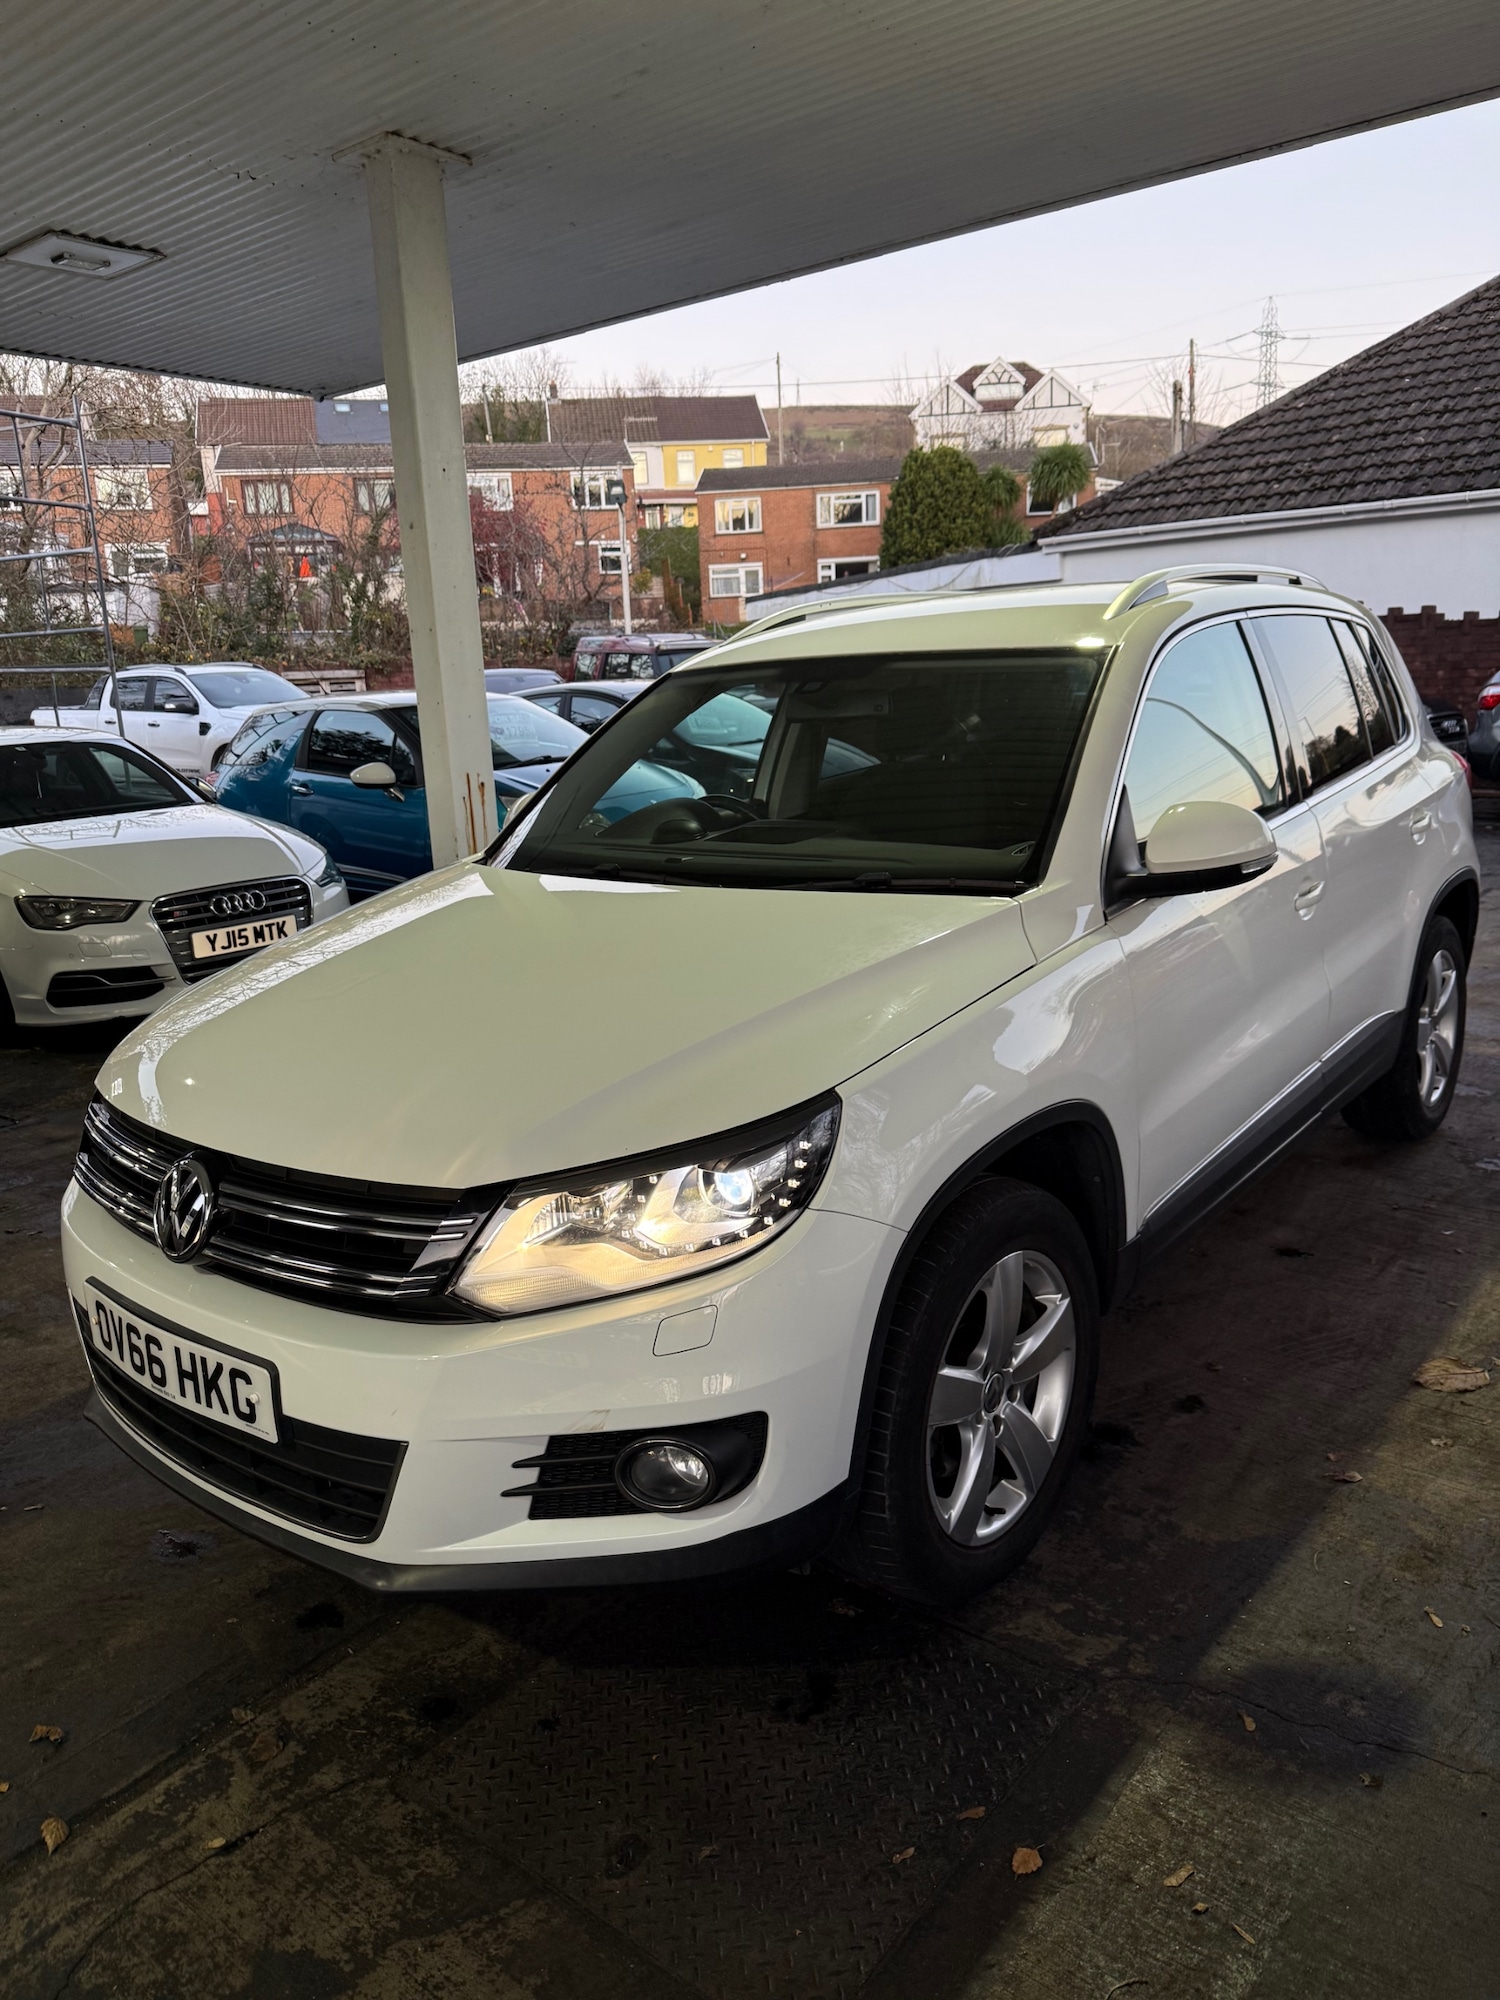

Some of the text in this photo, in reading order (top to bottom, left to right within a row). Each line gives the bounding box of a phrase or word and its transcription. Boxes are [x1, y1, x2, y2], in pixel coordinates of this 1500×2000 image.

[206, 920, 288, 952] YJ15 MTK
[95, 1300, 257, 1424] OV66 HKG
